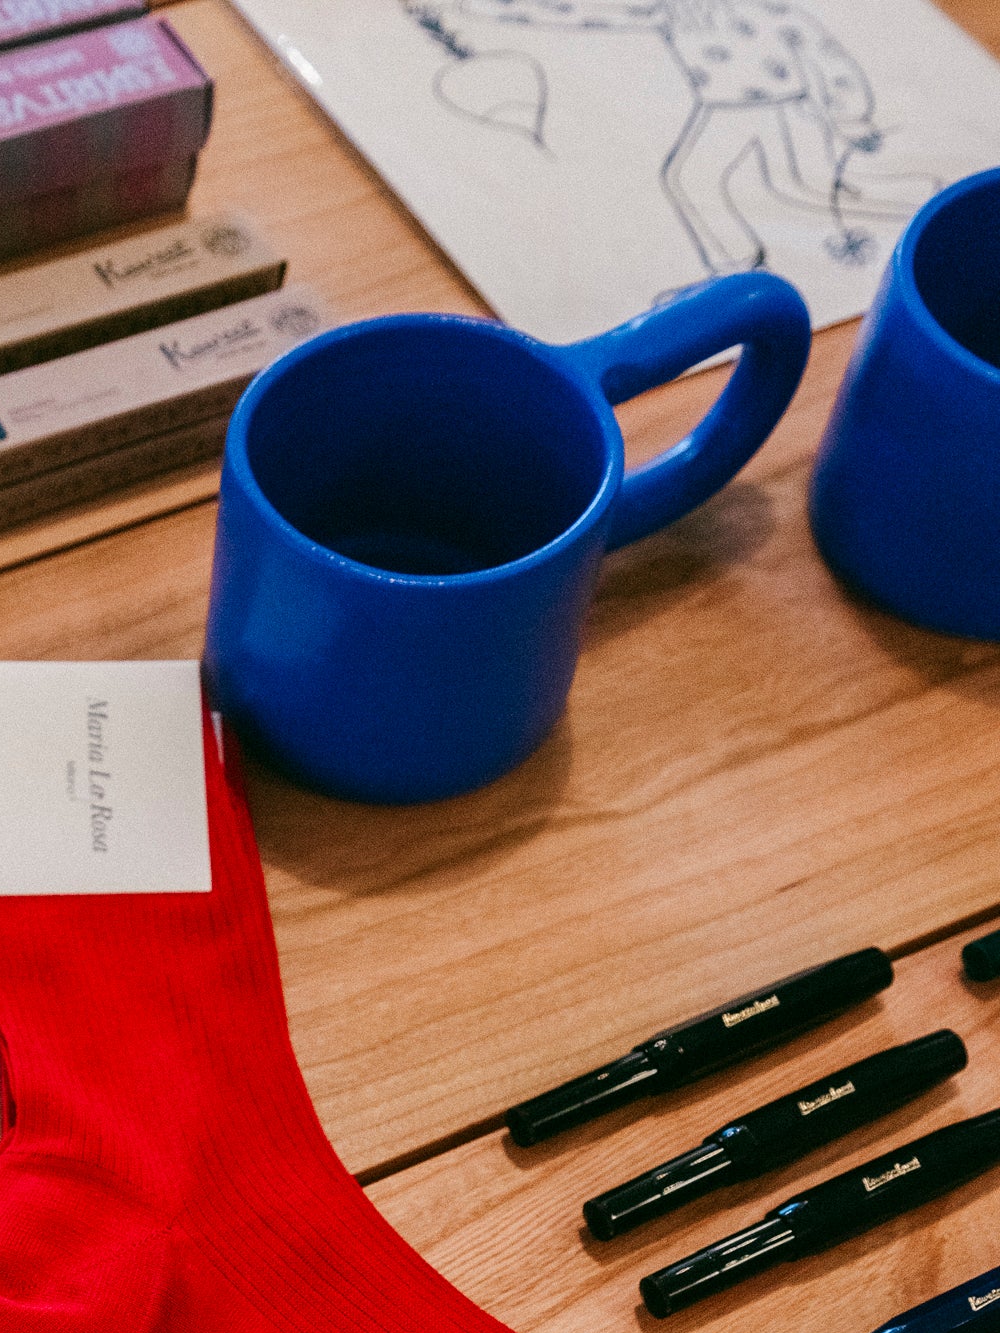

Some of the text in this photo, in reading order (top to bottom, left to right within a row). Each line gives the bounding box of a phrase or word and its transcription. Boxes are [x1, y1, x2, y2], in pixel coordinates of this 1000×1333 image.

[86, 696, 113, 852] Maria La Rosa
